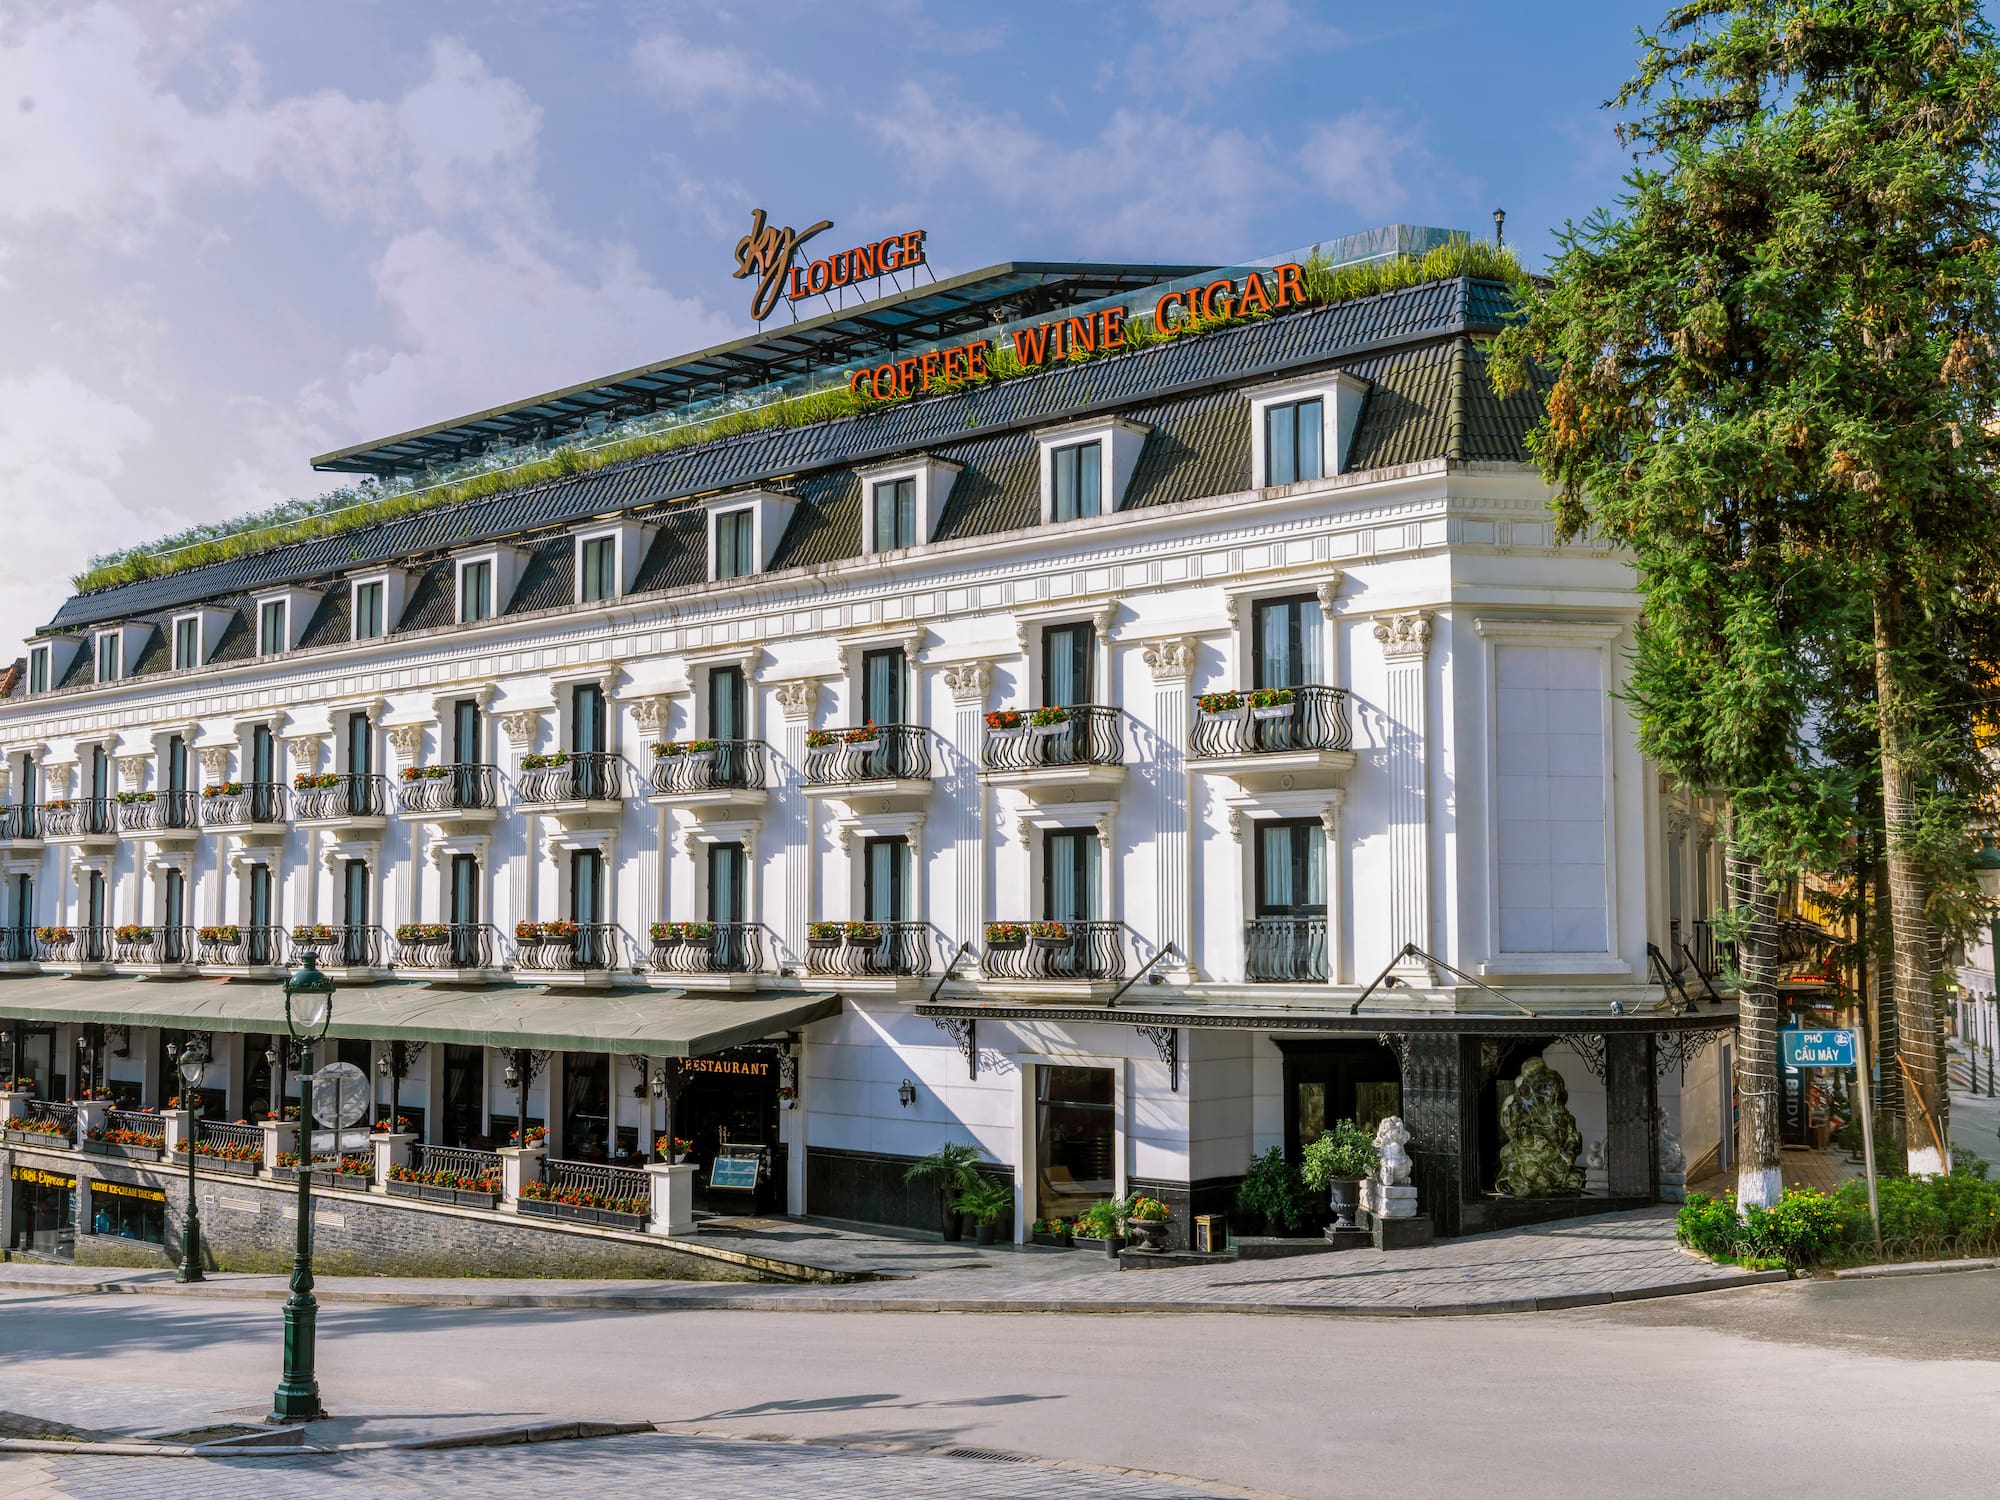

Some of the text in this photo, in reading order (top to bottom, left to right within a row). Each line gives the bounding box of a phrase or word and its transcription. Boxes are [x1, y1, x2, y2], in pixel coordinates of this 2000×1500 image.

[788, 230, 927, 301] LOUNGE
[850, 262, 1307, 403] COFFEE WINE CIGAR
[1803, 1031, 1823, 1044] PHỐ
[1794, 1045, 1839, 1061] CẦU MÂY
[685, 1059, 769, 1076] RESTAURANT
